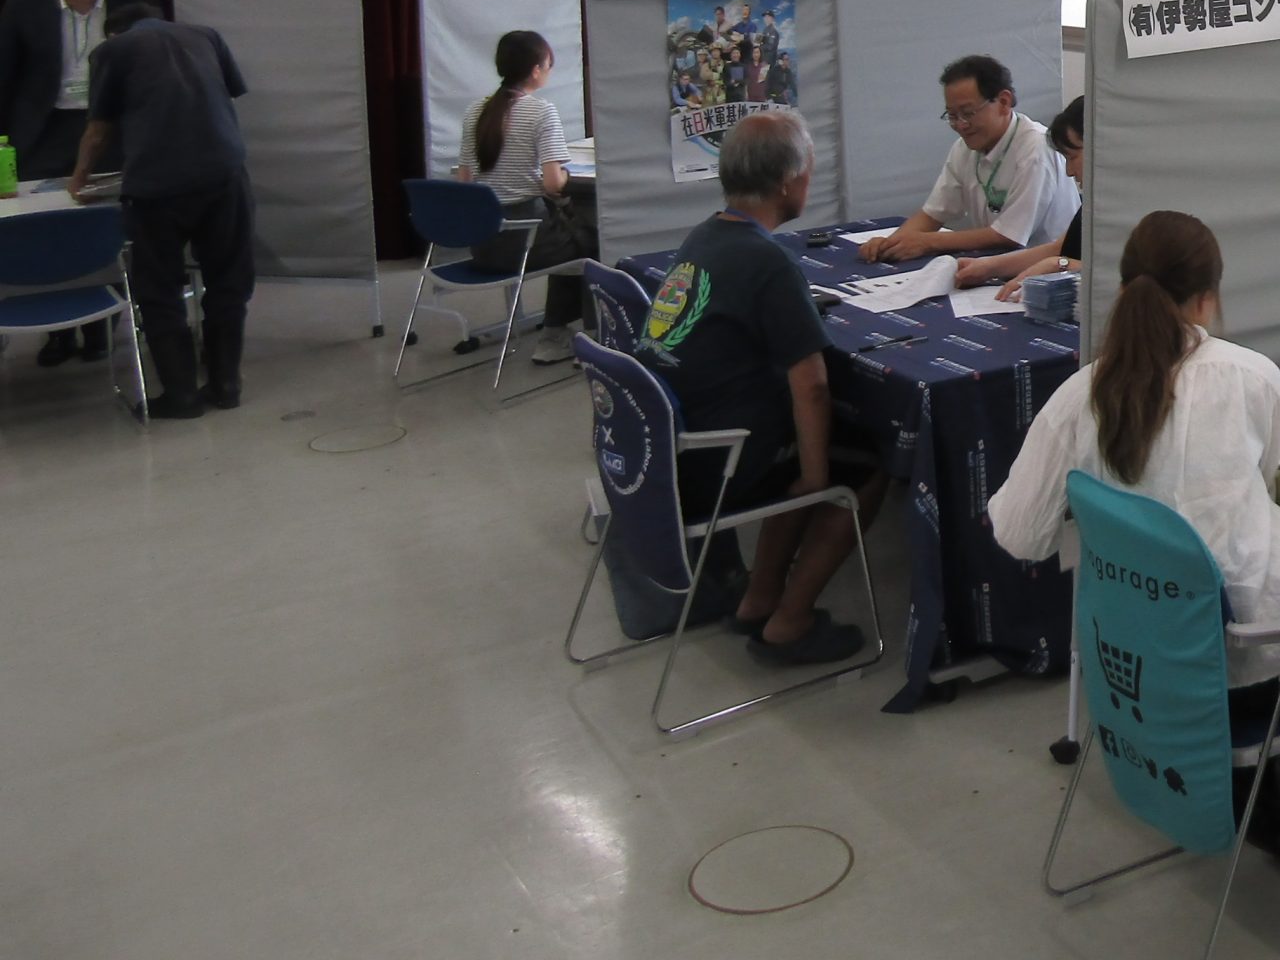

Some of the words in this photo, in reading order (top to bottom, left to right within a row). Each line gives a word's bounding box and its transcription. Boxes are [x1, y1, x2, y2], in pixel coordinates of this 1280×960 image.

[681, 102, 792, 138] 在日米軍基地
